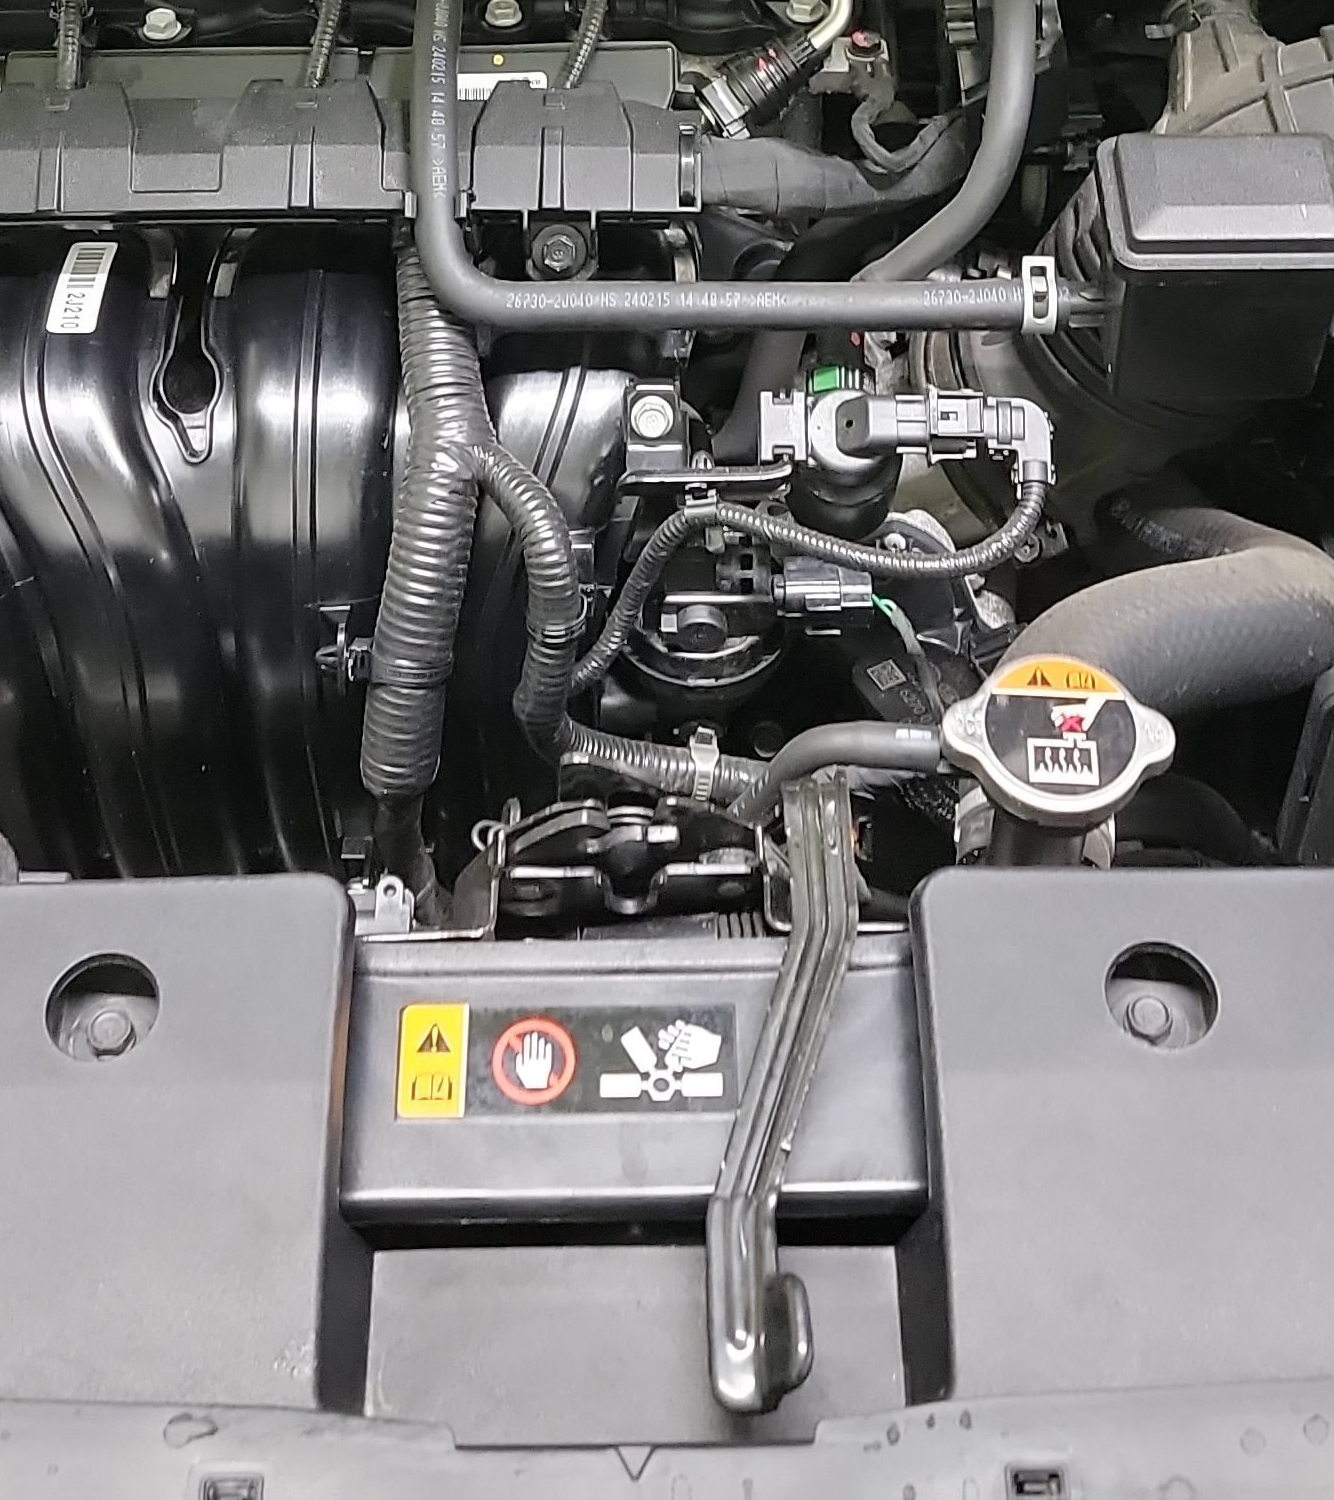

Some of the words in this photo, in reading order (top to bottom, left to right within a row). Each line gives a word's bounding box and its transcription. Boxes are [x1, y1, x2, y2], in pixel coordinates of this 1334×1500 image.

[60, 293, 86, 328] 2J210
[506, 292, 593, 309] 26730-2J040
[624, 291, 671, 307] 240215
